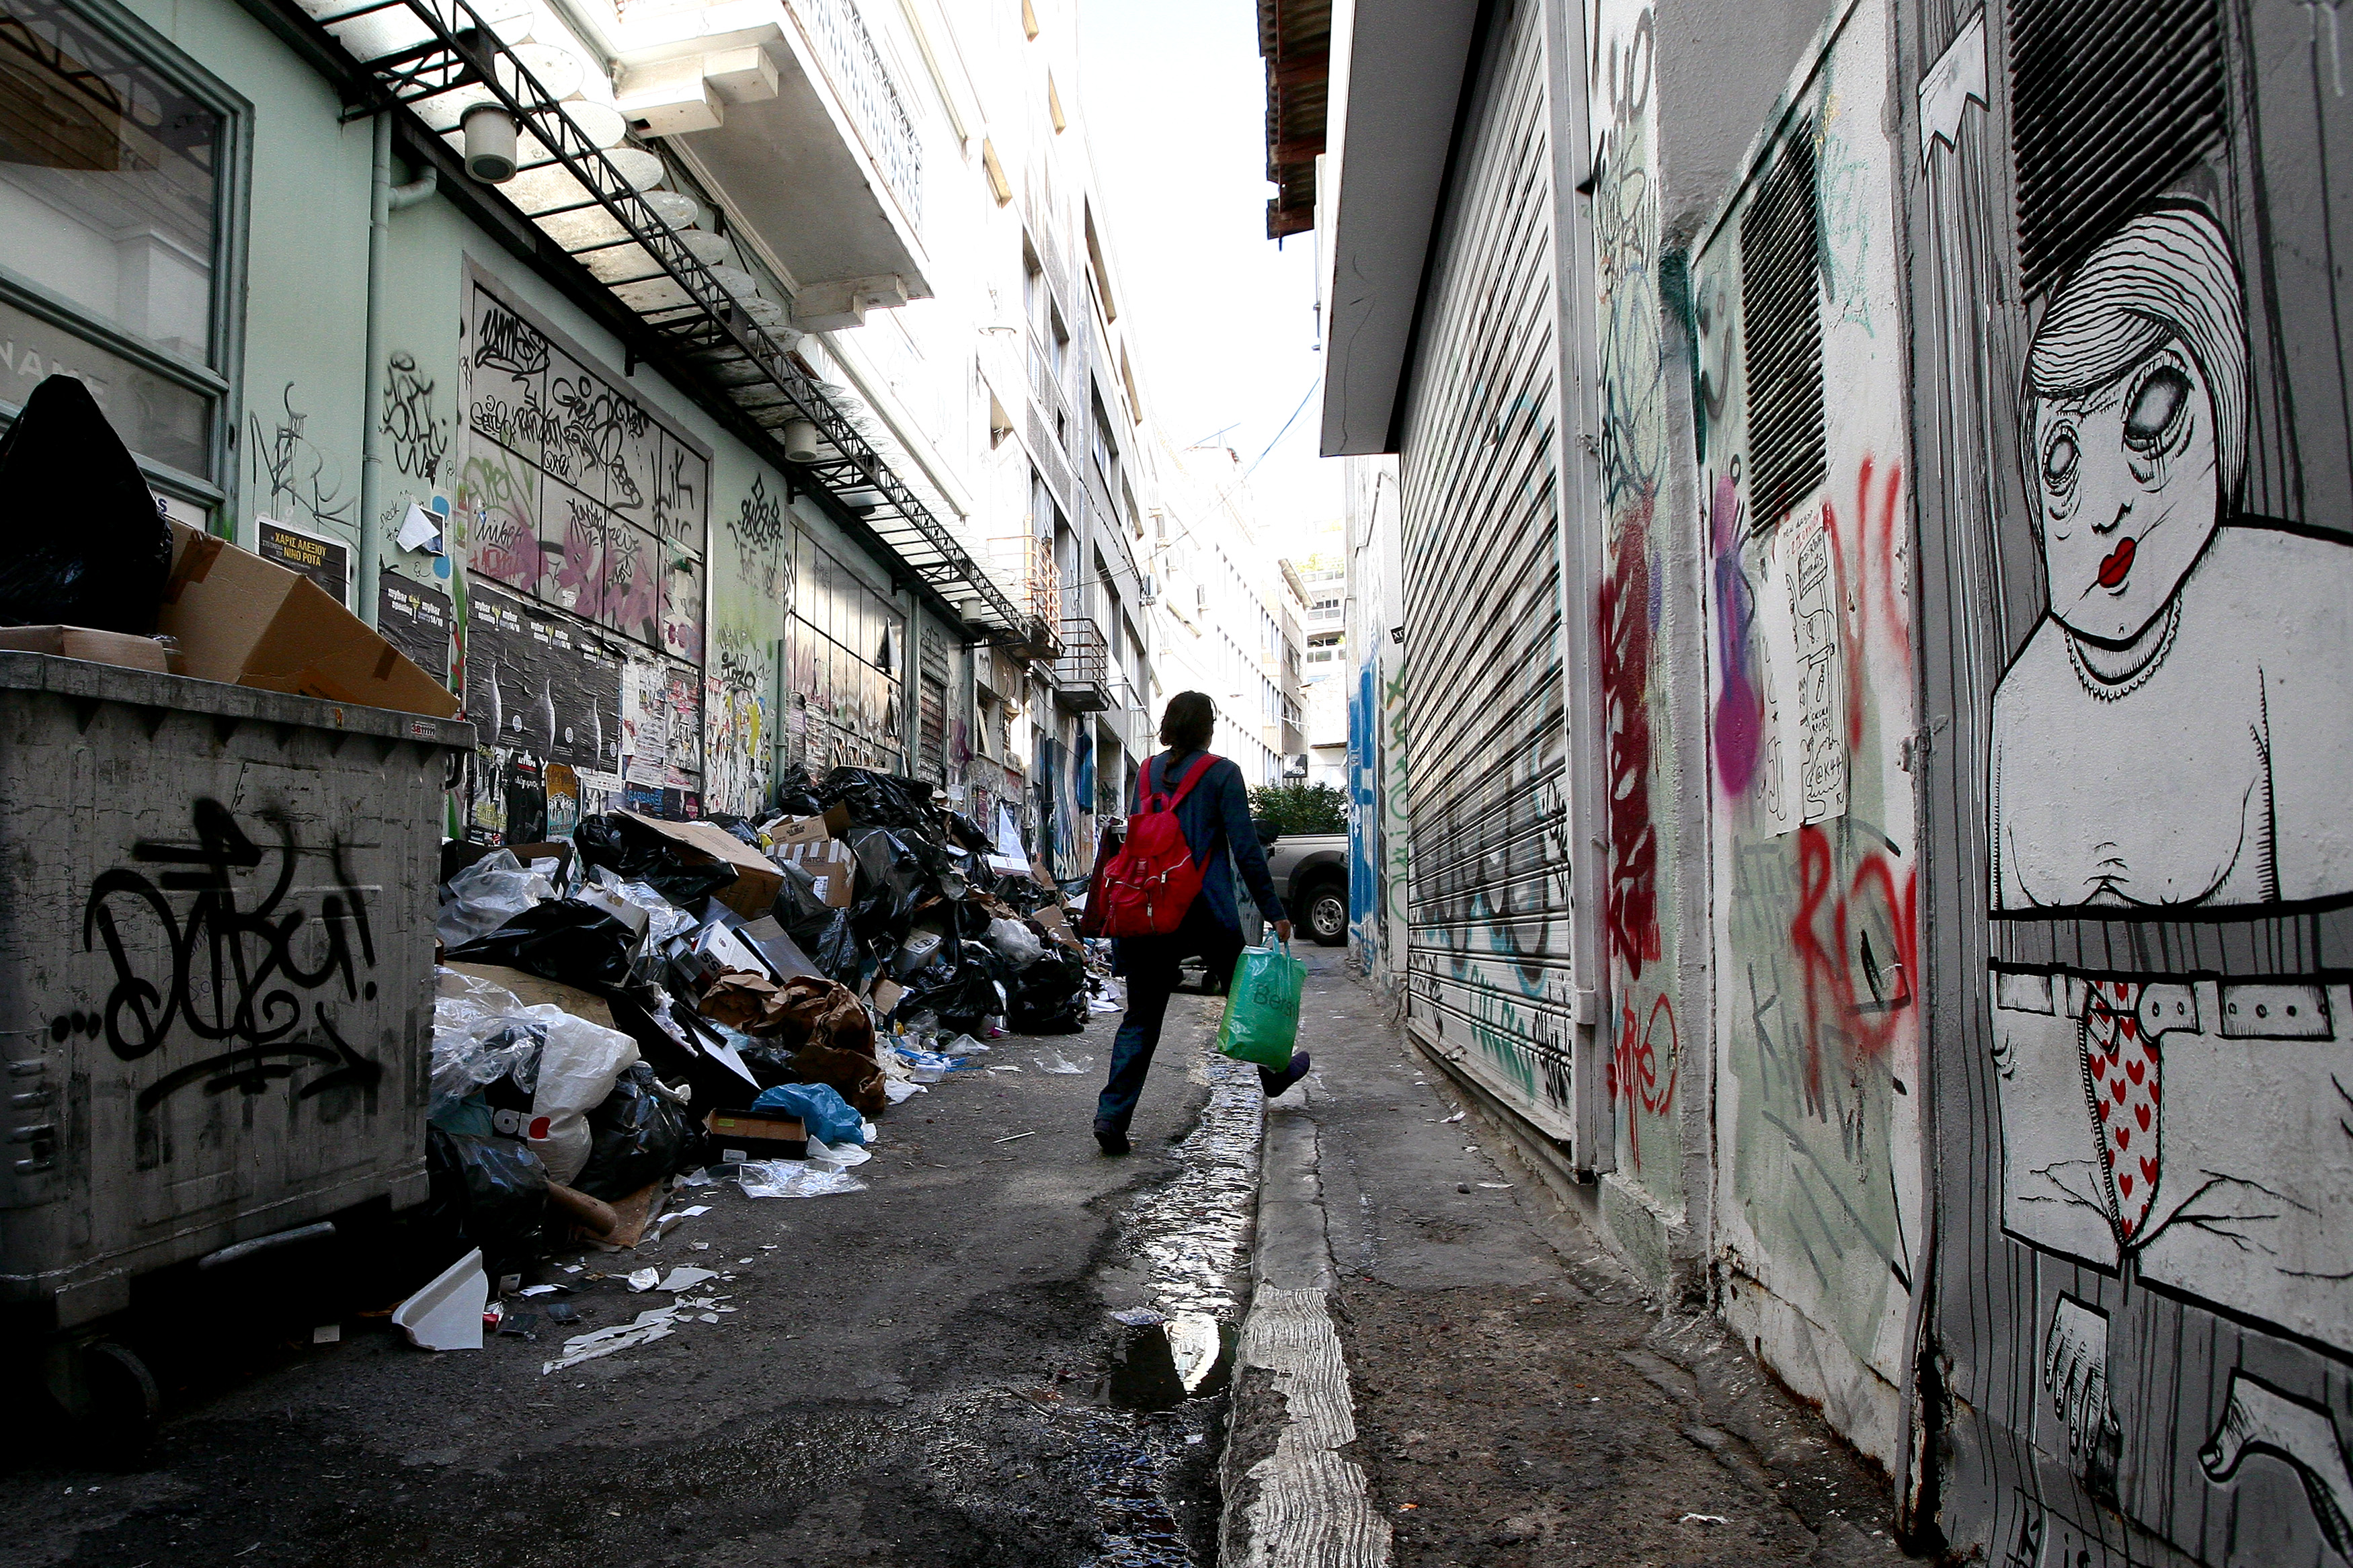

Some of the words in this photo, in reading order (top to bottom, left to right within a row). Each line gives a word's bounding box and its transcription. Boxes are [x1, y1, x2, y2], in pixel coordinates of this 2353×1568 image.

[274, 532, 296, 548] ΧΑΡΙΣ
[297, 540, 327, 556] ΑΛΕΞΙΟΥ
[283, 547, 301, 561] ΝΙΝΟ
[303, 552, 321, 567] ΡΟΤΑ
